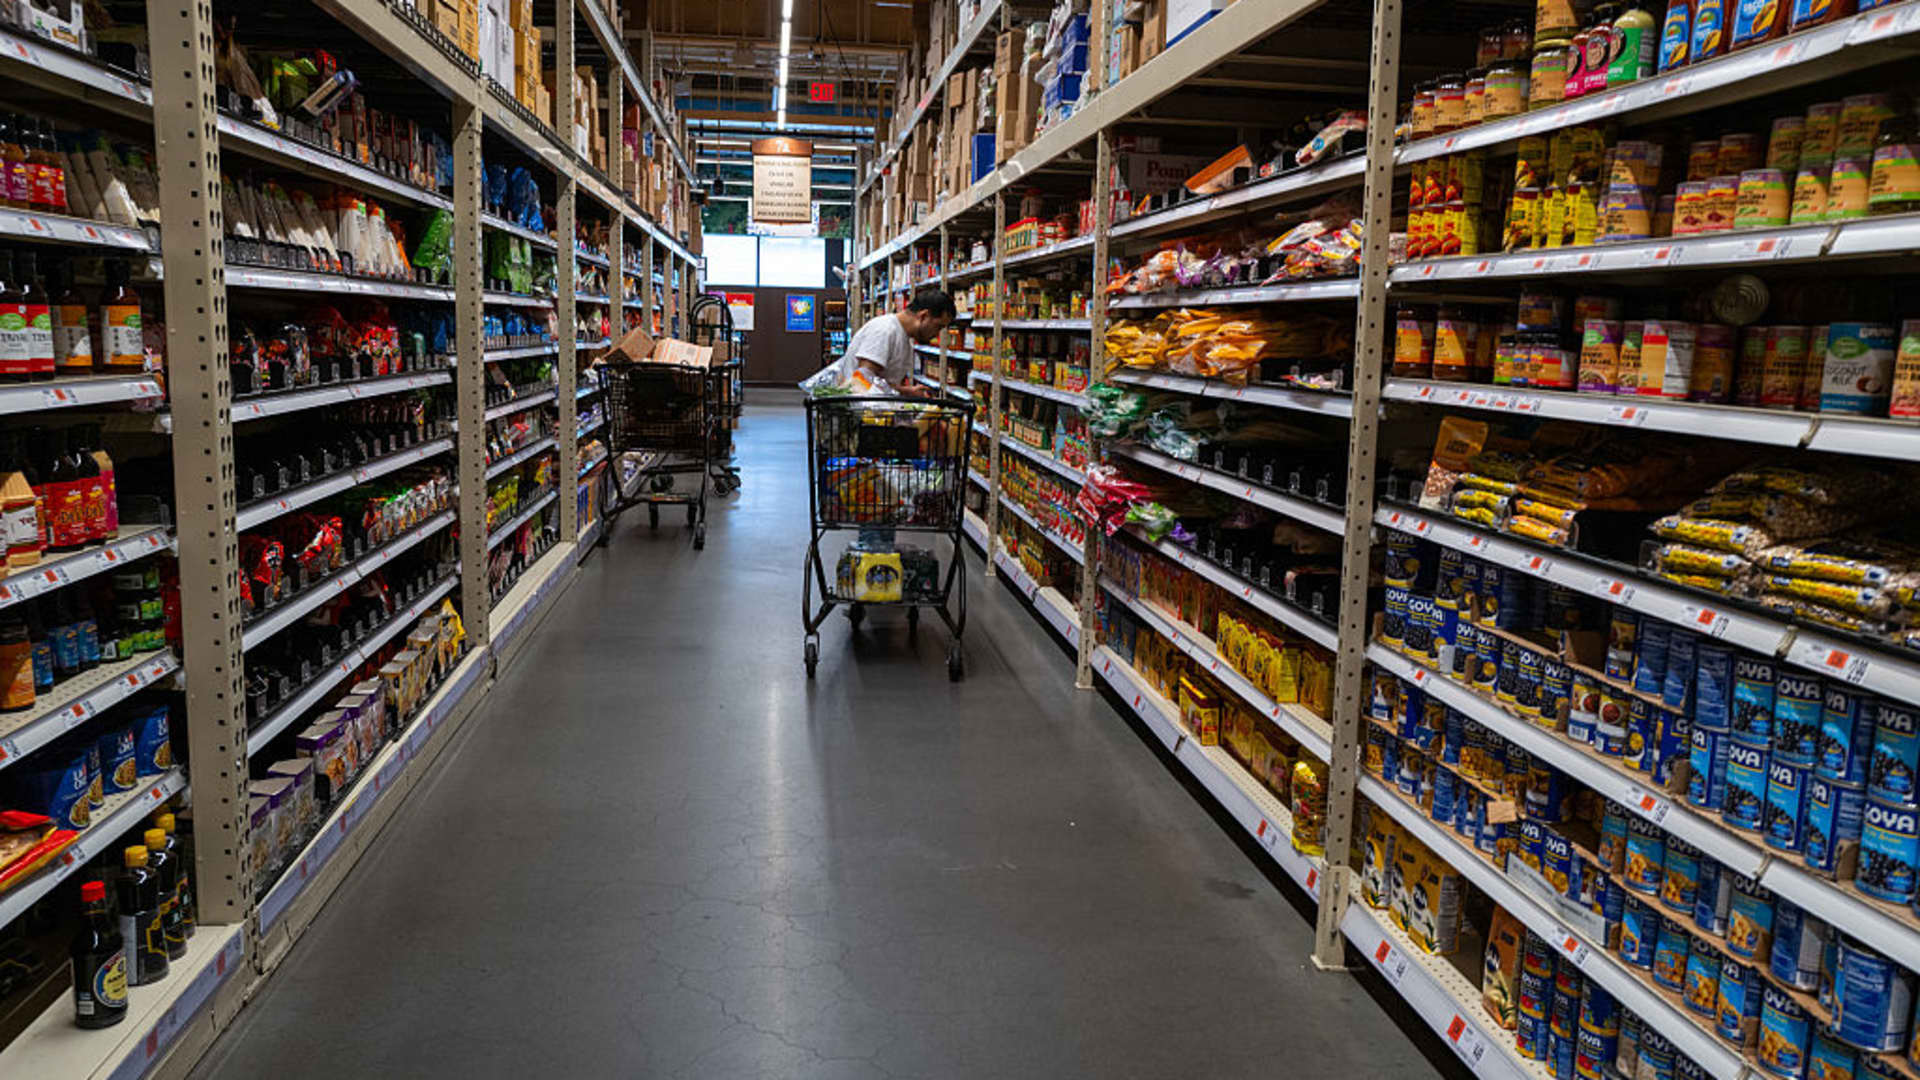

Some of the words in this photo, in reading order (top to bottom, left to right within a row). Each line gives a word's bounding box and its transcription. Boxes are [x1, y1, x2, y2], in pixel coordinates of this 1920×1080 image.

[811, 83, 834, 101] EXIT
[776, 140, 790, 153] 7A
[1408, 600, 1444, 621] GOYA
[1544, 663, 1570, 679] OYA
[1737, 660, 1772, 681] OYA
[1780, 679, 1820, 699] OYA
[1730, 745, 1760, 766] OYA
[1764, 987, 1800, 1015] OYA
